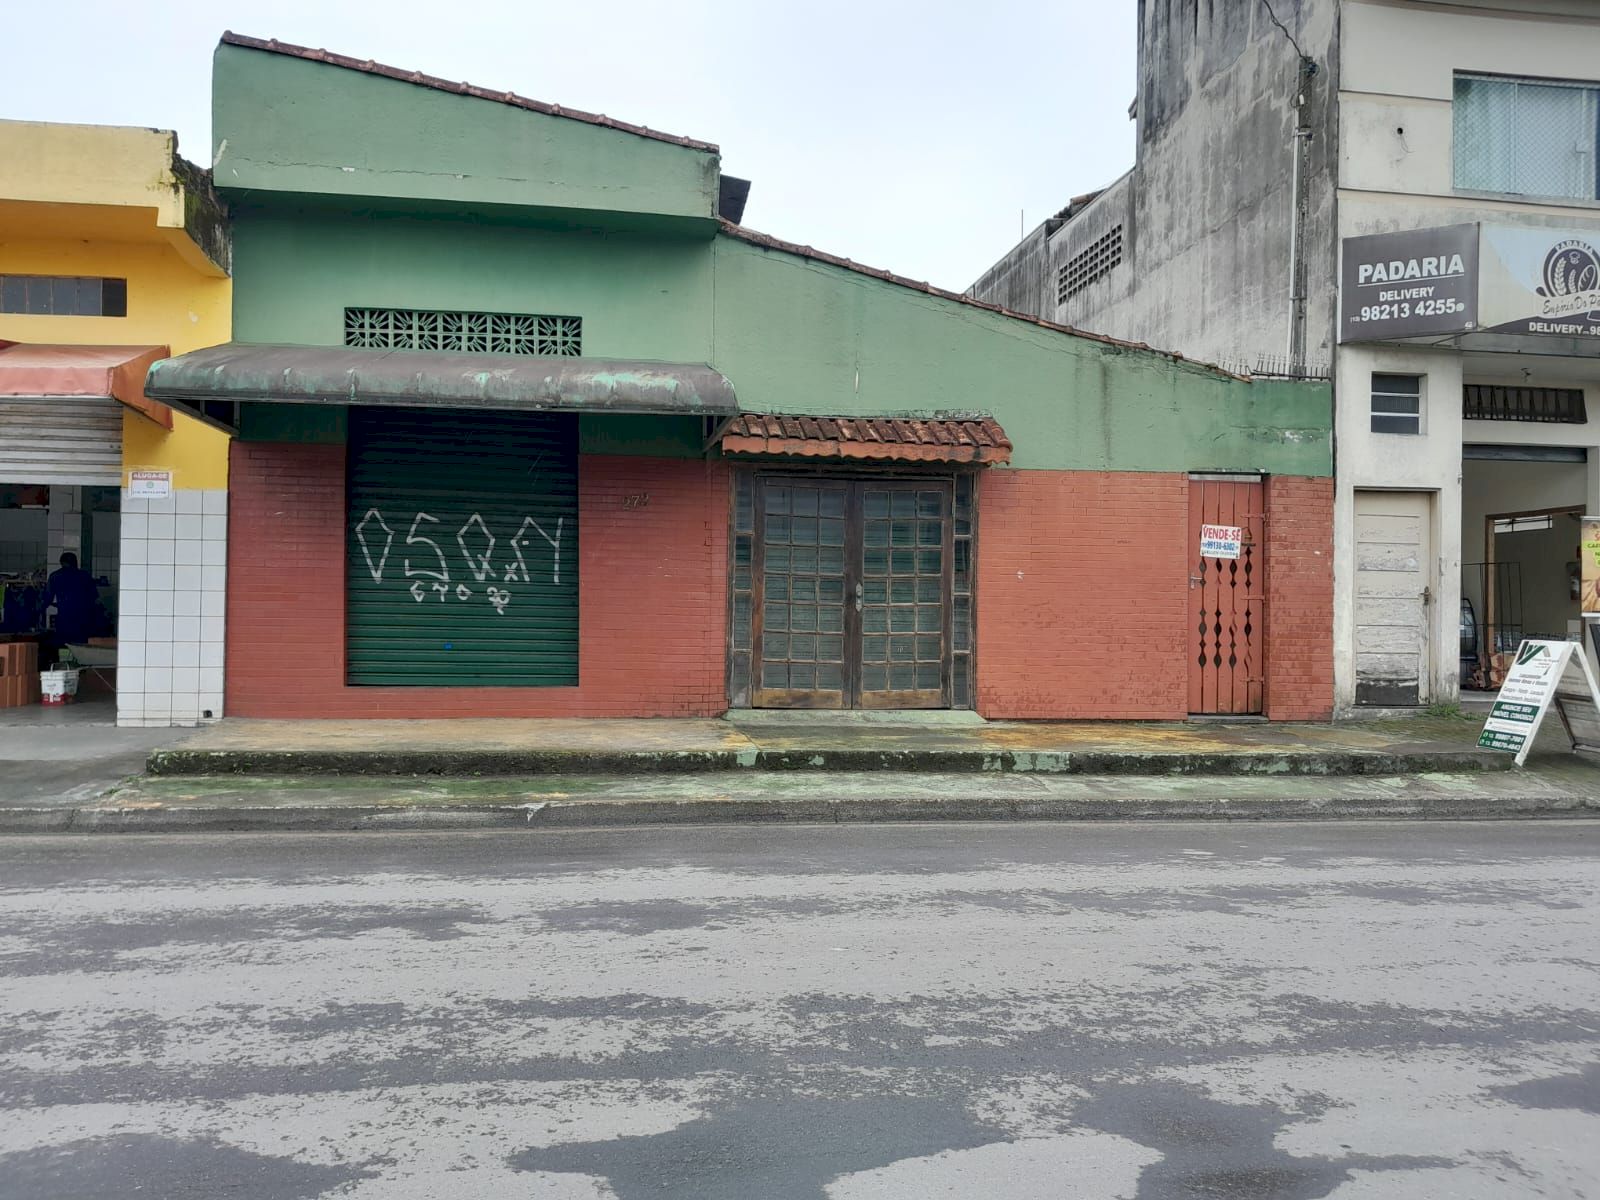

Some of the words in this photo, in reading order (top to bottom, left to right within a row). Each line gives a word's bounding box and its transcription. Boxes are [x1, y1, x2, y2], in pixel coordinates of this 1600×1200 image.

[1556, 240, 1594, 254] PADARIA
[1358, 254, 1465, 284] PADARIA
[1379, 286, 1435, 302] DELIVERY
[1361, 303, 1410, 322] 98213
[1415, 298, 1456, 316] 4255
[1529, 321, 1584, 335] DELIVERY
[1203, 527, 1241, 541] VENDE-SE
